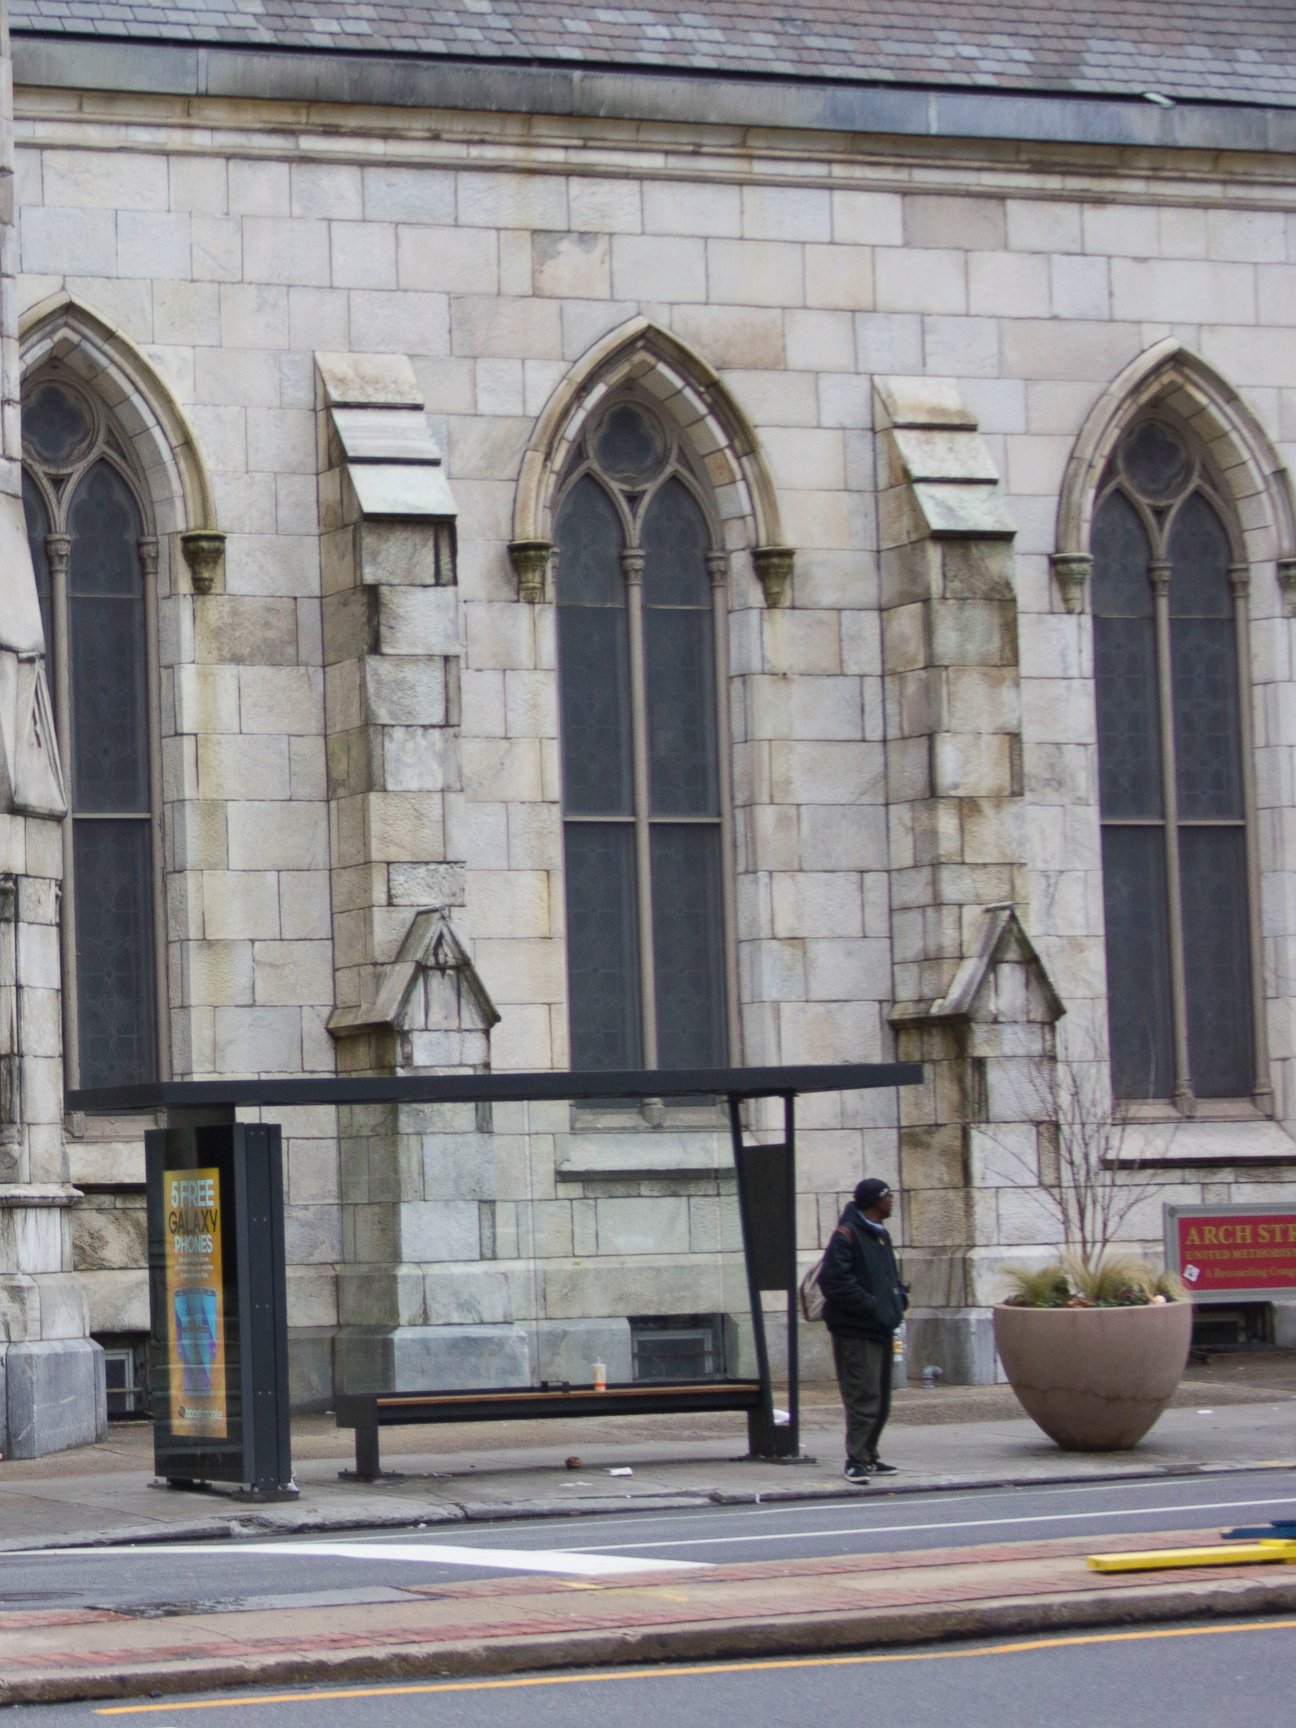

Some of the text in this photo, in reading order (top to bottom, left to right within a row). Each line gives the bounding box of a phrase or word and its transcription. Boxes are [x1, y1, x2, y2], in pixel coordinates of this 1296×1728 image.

[171, 1178, 215, 1208] 5 FREE
[168, 1209, 218, 1234] GALAXY
[174, 1234, 213, 1254] PHONES
[1185, 1225, 1252, 1244] ARCH
[1185, 1250, 1230, 1260] UNITED
